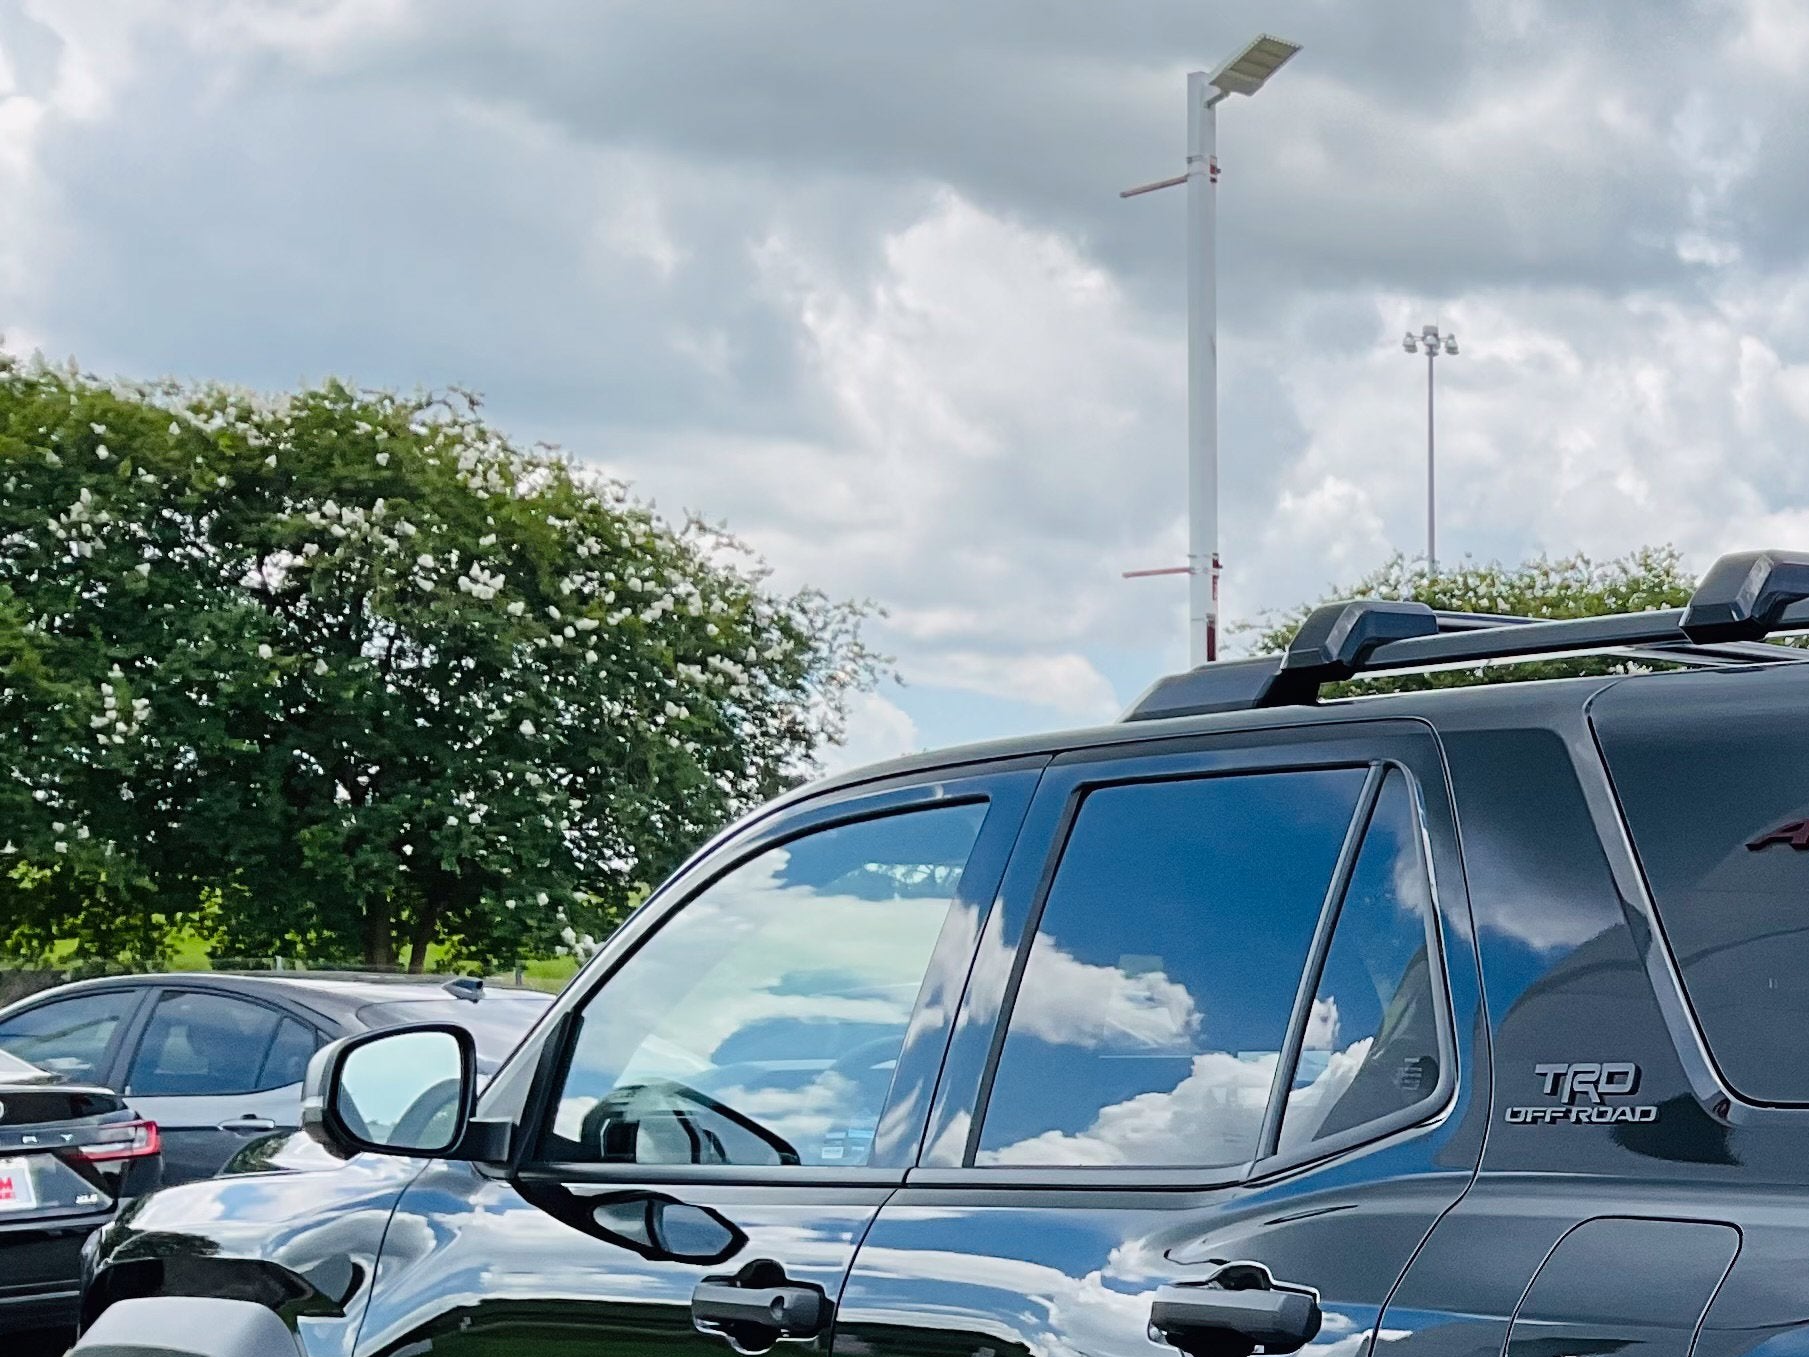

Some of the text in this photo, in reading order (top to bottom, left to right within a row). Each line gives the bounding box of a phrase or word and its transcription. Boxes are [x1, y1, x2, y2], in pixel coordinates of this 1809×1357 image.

[1534, 1062, 1640, 1104] TRD
[1504, 1105, 1659, 1124] OFF ROAD
